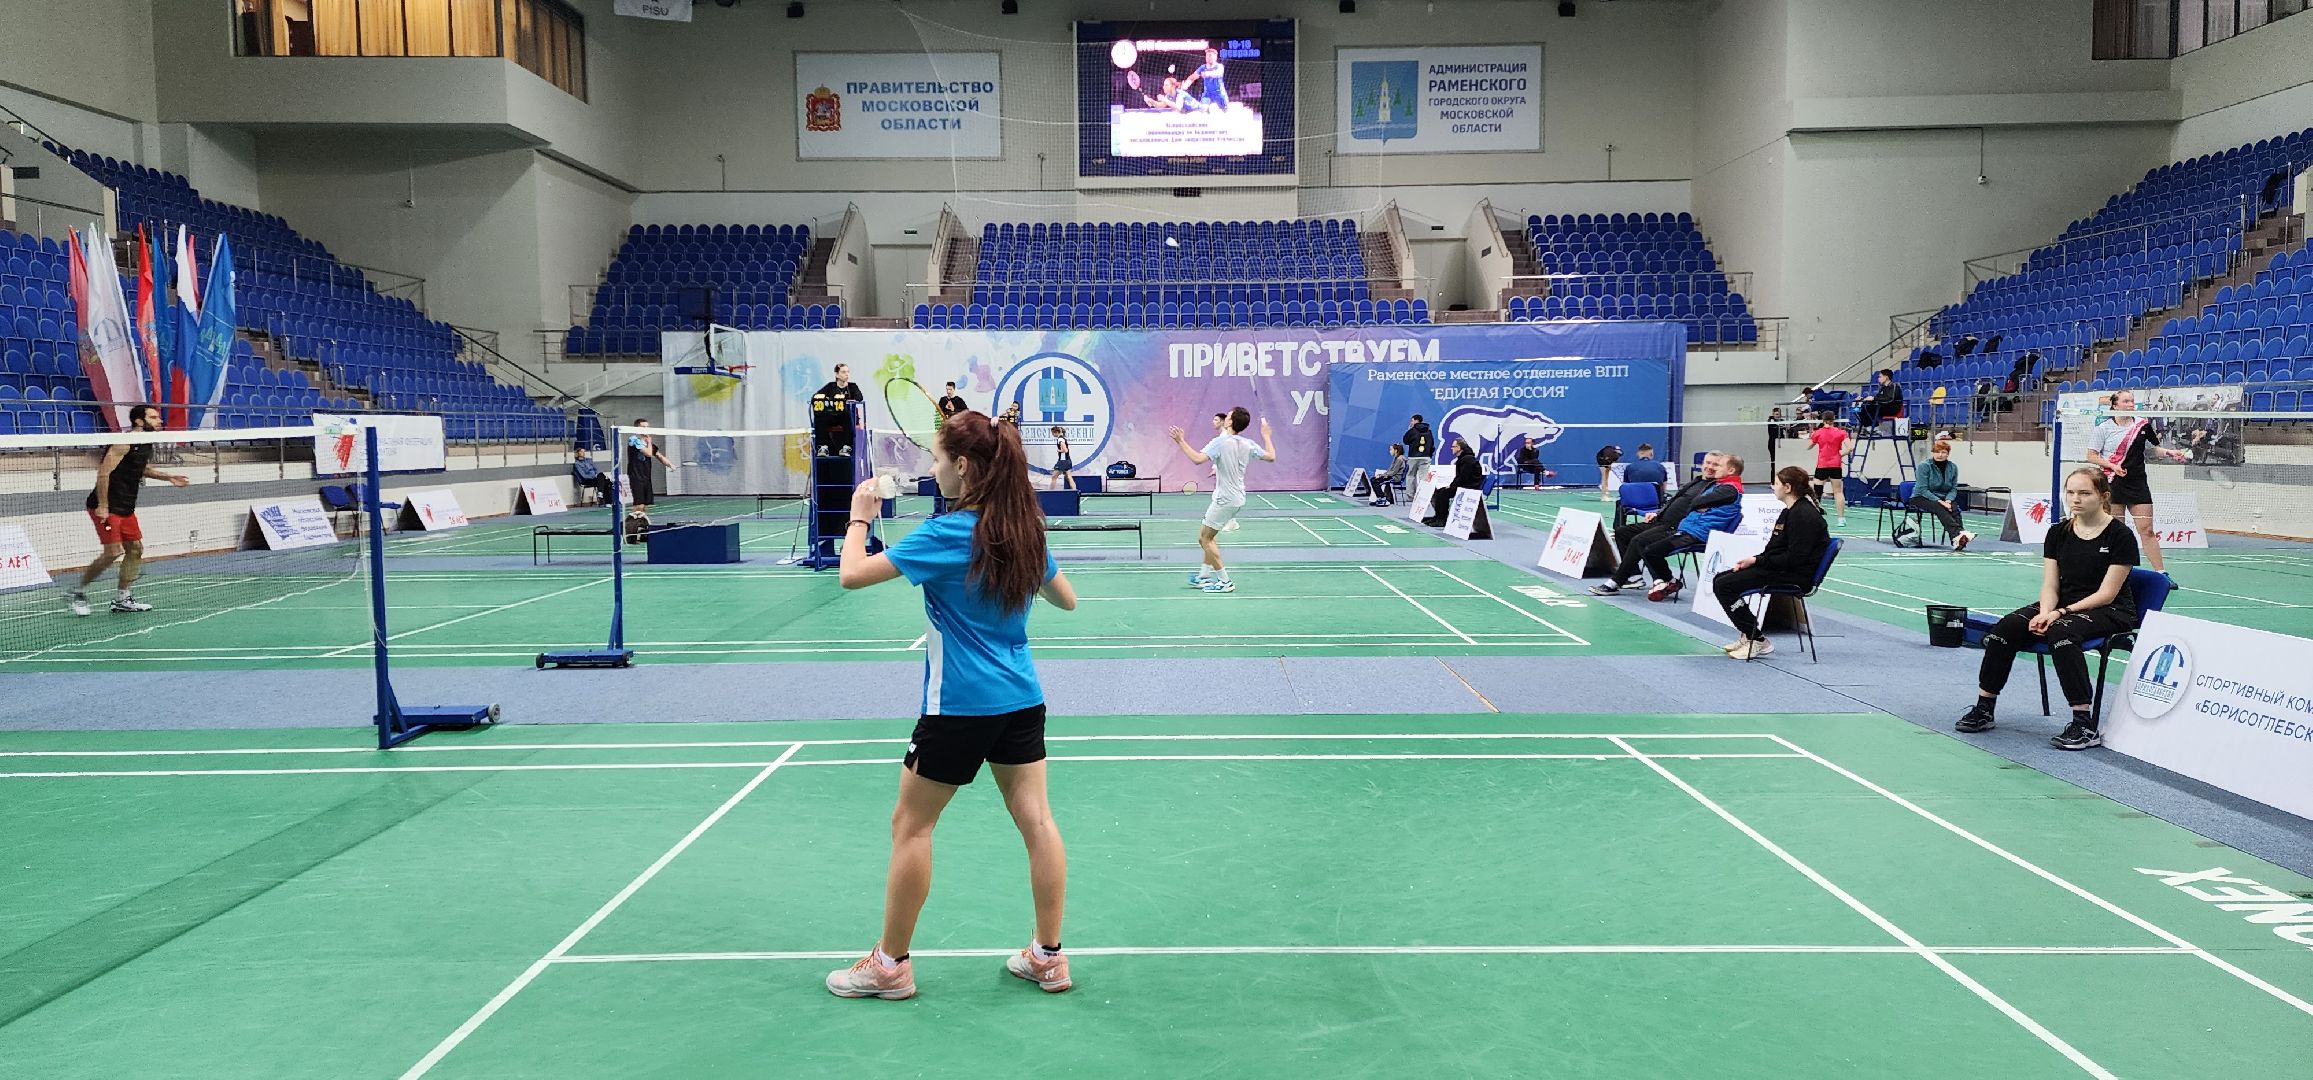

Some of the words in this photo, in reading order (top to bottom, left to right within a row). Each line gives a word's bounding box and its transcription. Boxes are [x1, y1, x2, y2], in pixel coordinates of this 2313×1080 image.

[642, 4, 669, 16] FISU
[1429, 63, 1527, 75] АДМИНИСТРАЦИЯ
[846, 82, 994, 94] ПРАВИТЕЛЬСТВО
[1429, 78, 1527, 92] РАМЕНСКОГО
[862, 98, 979, 112] МОСКОВСКОЙ
[1429, 97, 1489, 107] ГОРОДСКОГО
[1490, 96, 1527, 105] ОКРУГА
[1440, 107, 1514, 119] МОСКОВСКОЙ
[881, 118, 961, 130] ОБЛАСТИ
[1452, 124, 1502, 133] ОБЛАСТИ
[1168, 339, 1440, 378] ПРИВЕТСТВУЕМ
[1368, 369, 1446, 381] Раменское
[1450, 369, 1510, 380] местное
[1513, 368, 1592, 380] отделение
[1594, 365, 1629, 378] ВПП
[813, 400, 825, 411] 20
[833, 400, 845, 411] 14
[2196, 674, 2285, 706] СПОРТИВНЫЙ
